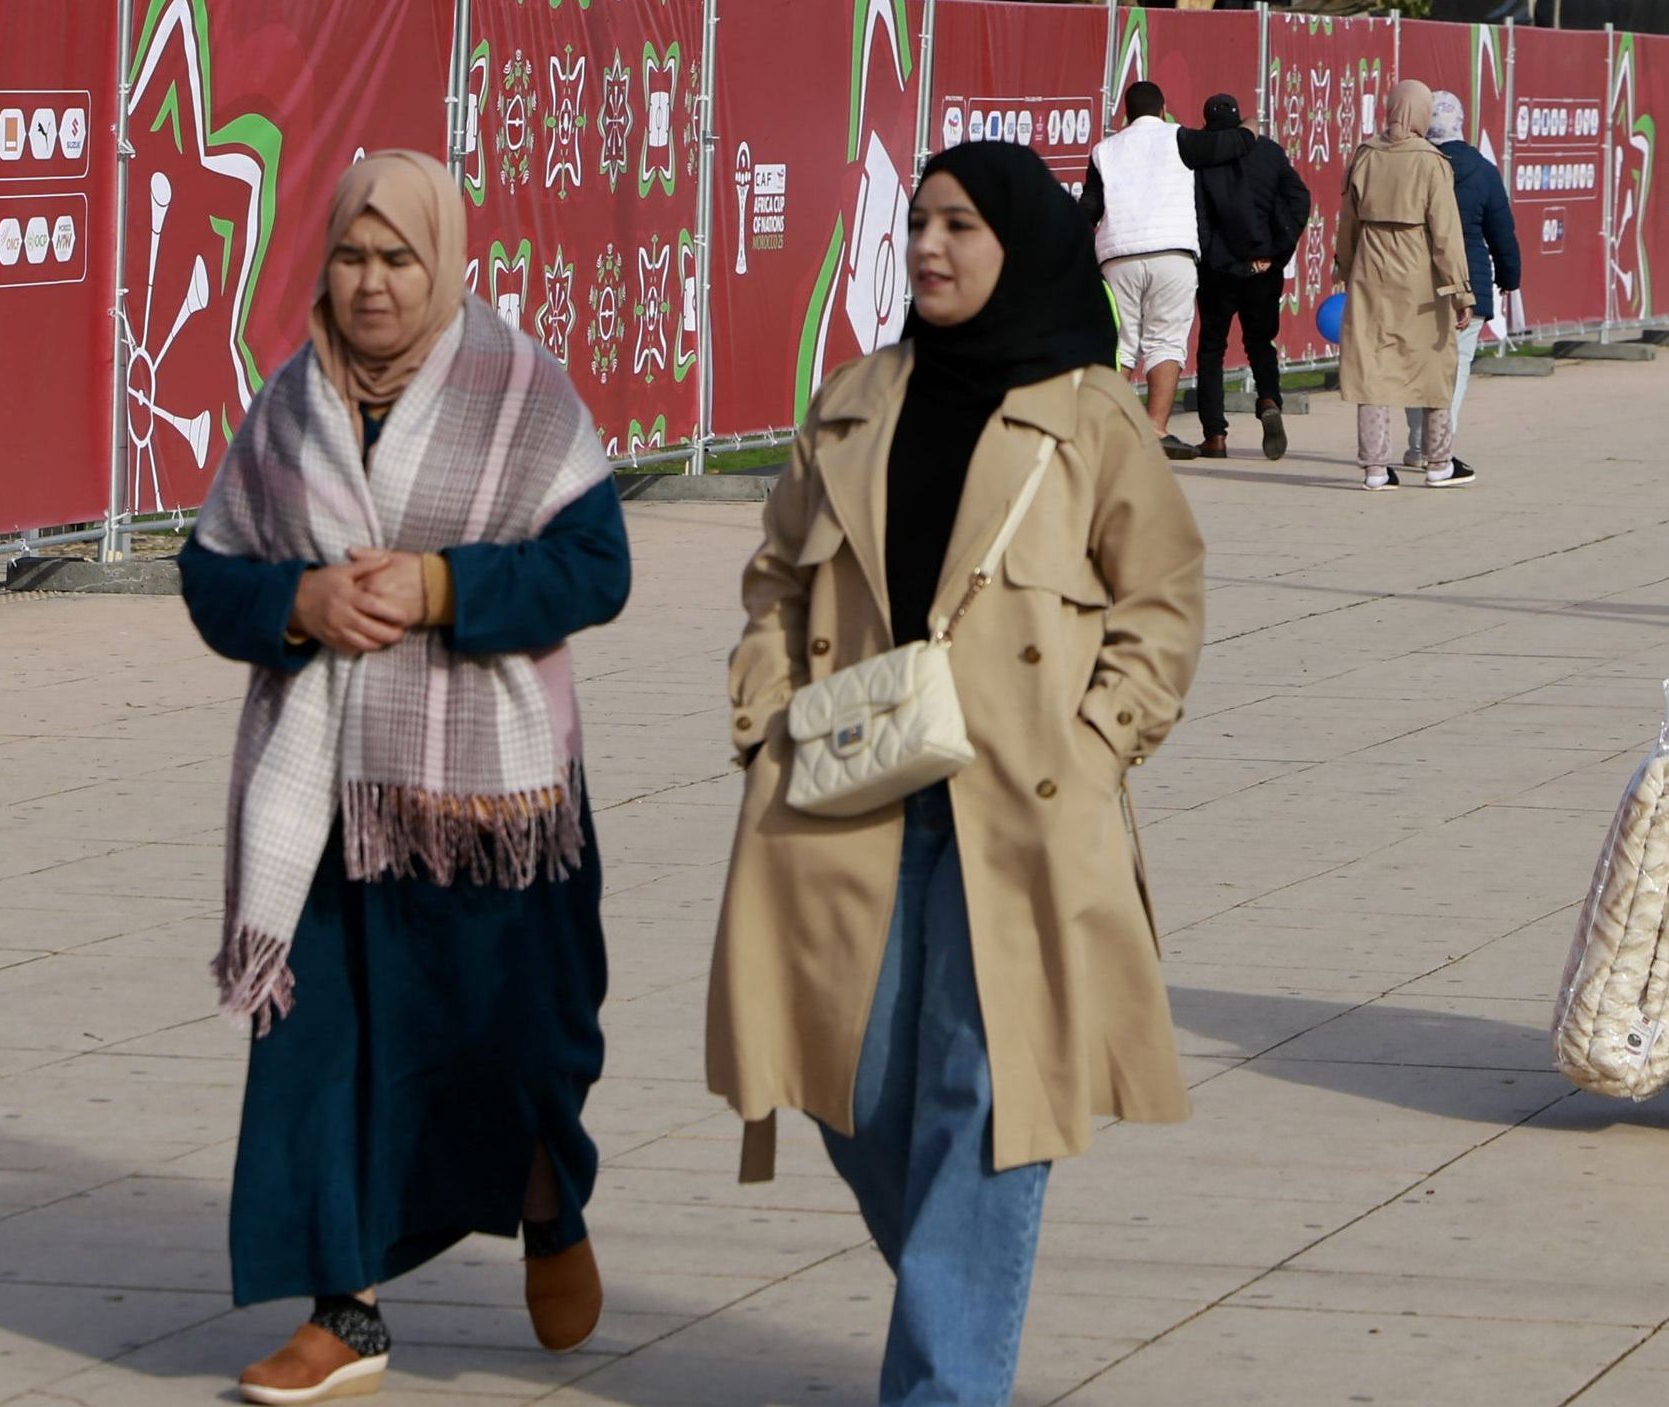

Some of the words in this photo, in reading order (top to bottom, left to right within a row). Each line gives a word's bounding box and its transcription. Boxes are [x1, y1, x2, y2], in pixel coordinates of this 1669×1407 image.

[756, 172, 771, 186] CAF
[754, 196, 774, 213] AFRICA
[774, 195, 785, 213] CUP
[753, 217, 761, 233] OF
[34, 235, 48, 247] OCP
